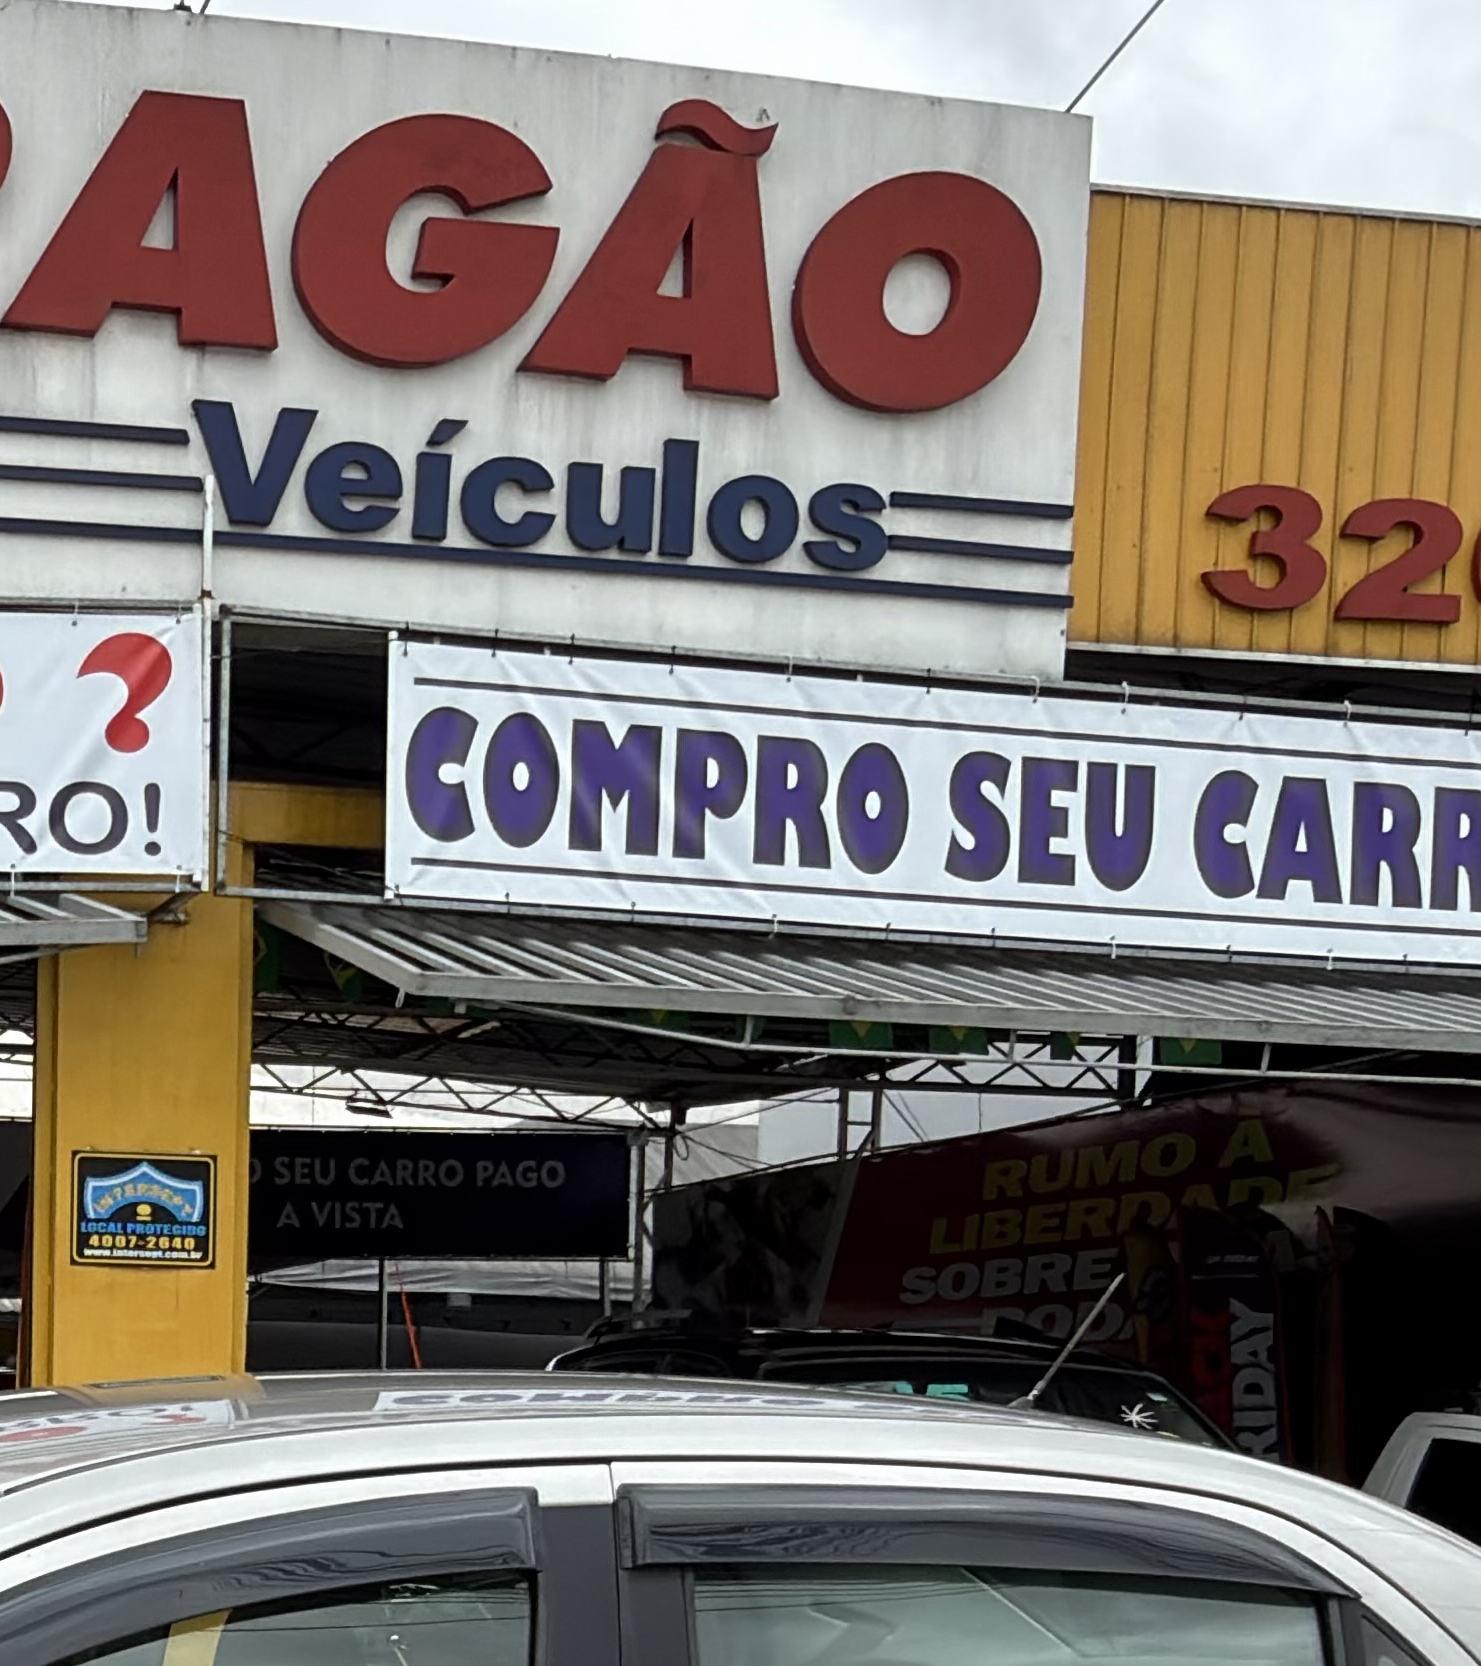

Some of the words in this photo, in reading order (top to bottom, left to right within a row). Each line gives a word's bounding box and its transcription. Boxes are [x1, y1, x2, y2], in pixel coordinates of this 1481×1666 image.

[192, 399, 888, 571] Veículos
[76, 631, 172, 754] ?
[405, 704, 910, 876] COMPRO
[944, 749, 1157, 892] SEU
[273, 1156, 336, 1187] SEU
[347, 1156, 466, 1189] CARRO
[475, 1158, 567, 1190] PAGO
[983, 1130, 1197, 1201] RUMO
[1217, 1115, 1275, 1169] A
[81, 1221, 124, 1233] LOCAL
[126, 1222, 207, 1237] PROTEGIDO
[88, 1234, 196, 1250] 4007-2640
[276, 1200, 302, 1230] A
[310, 1200, 405, 1230] VISTA
[899, 1247, 1122, 1306] SOBRE
